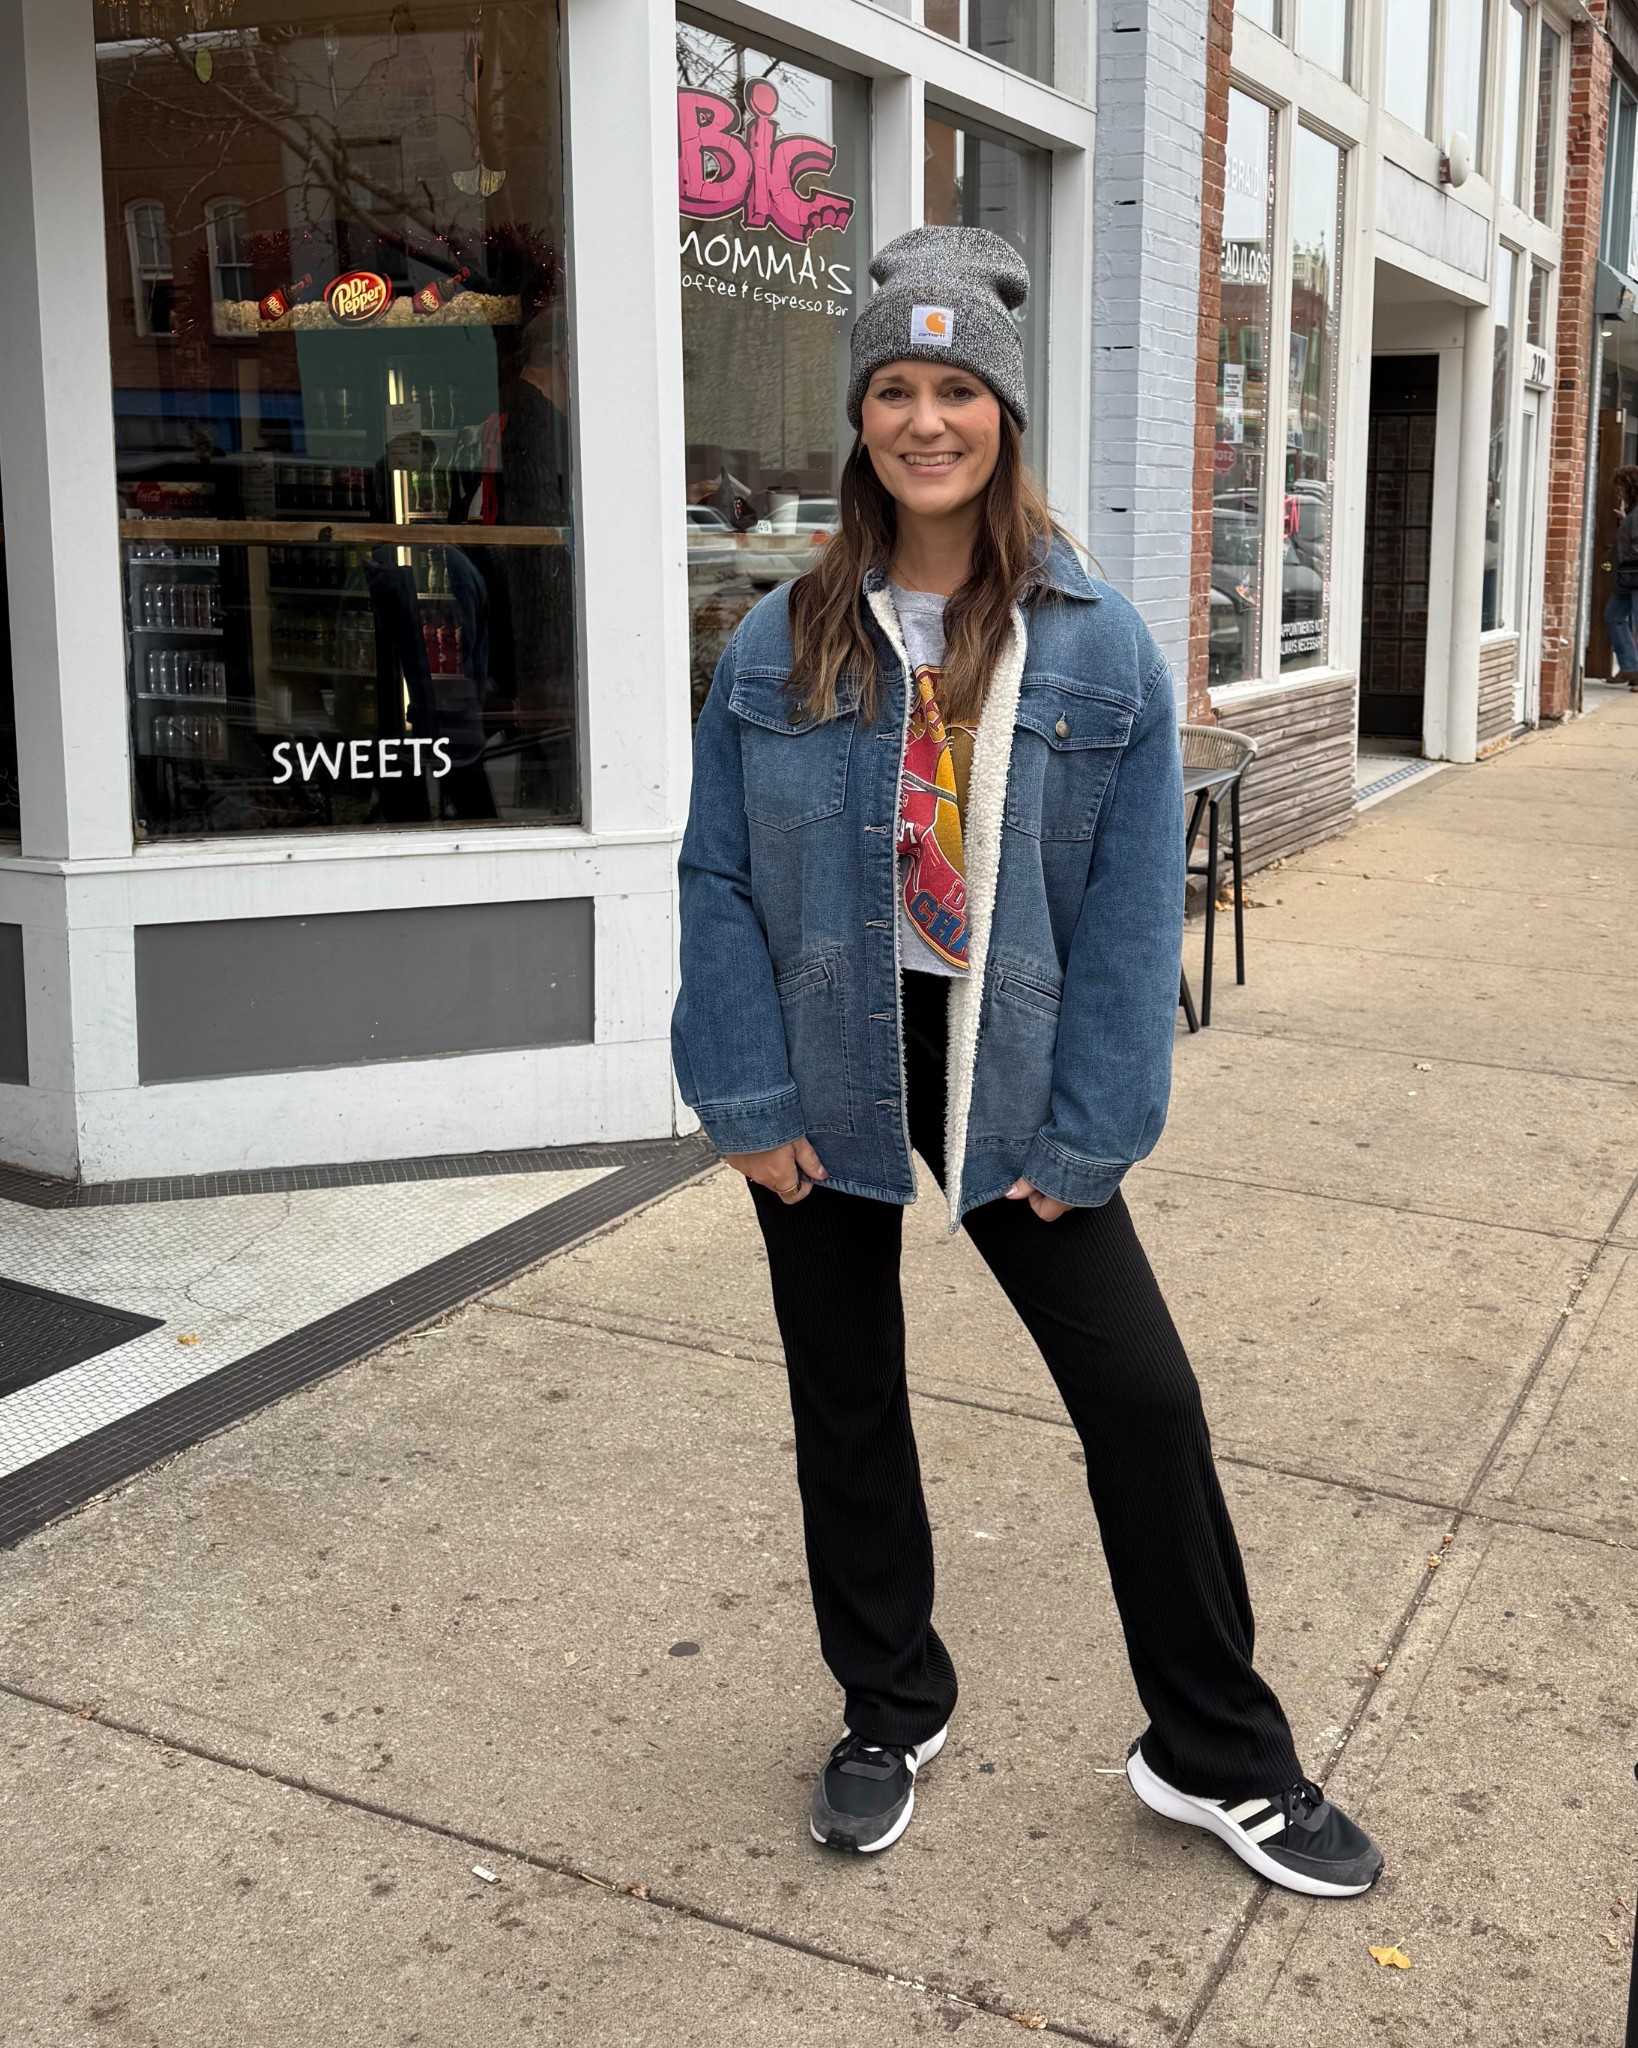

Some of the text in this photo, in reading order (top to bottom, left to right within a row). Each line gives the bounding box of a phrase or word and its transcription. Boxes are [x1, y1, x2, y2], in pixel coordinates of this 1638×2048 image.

[680, 231, 853, 295] MOMMA'S
[1221, 240, 1239, 276] EAD
[332, 283, 382, 317] Pepper
[350, 278, 369, 298] Dr
[682, 274, 737, 297] offee
[753, 287, 823, 311] Espresso
[826, 300, 848, 317] Bar
[1531, 353, 1545, 383] 219
[272, 737, 452, 785] SWEETS
